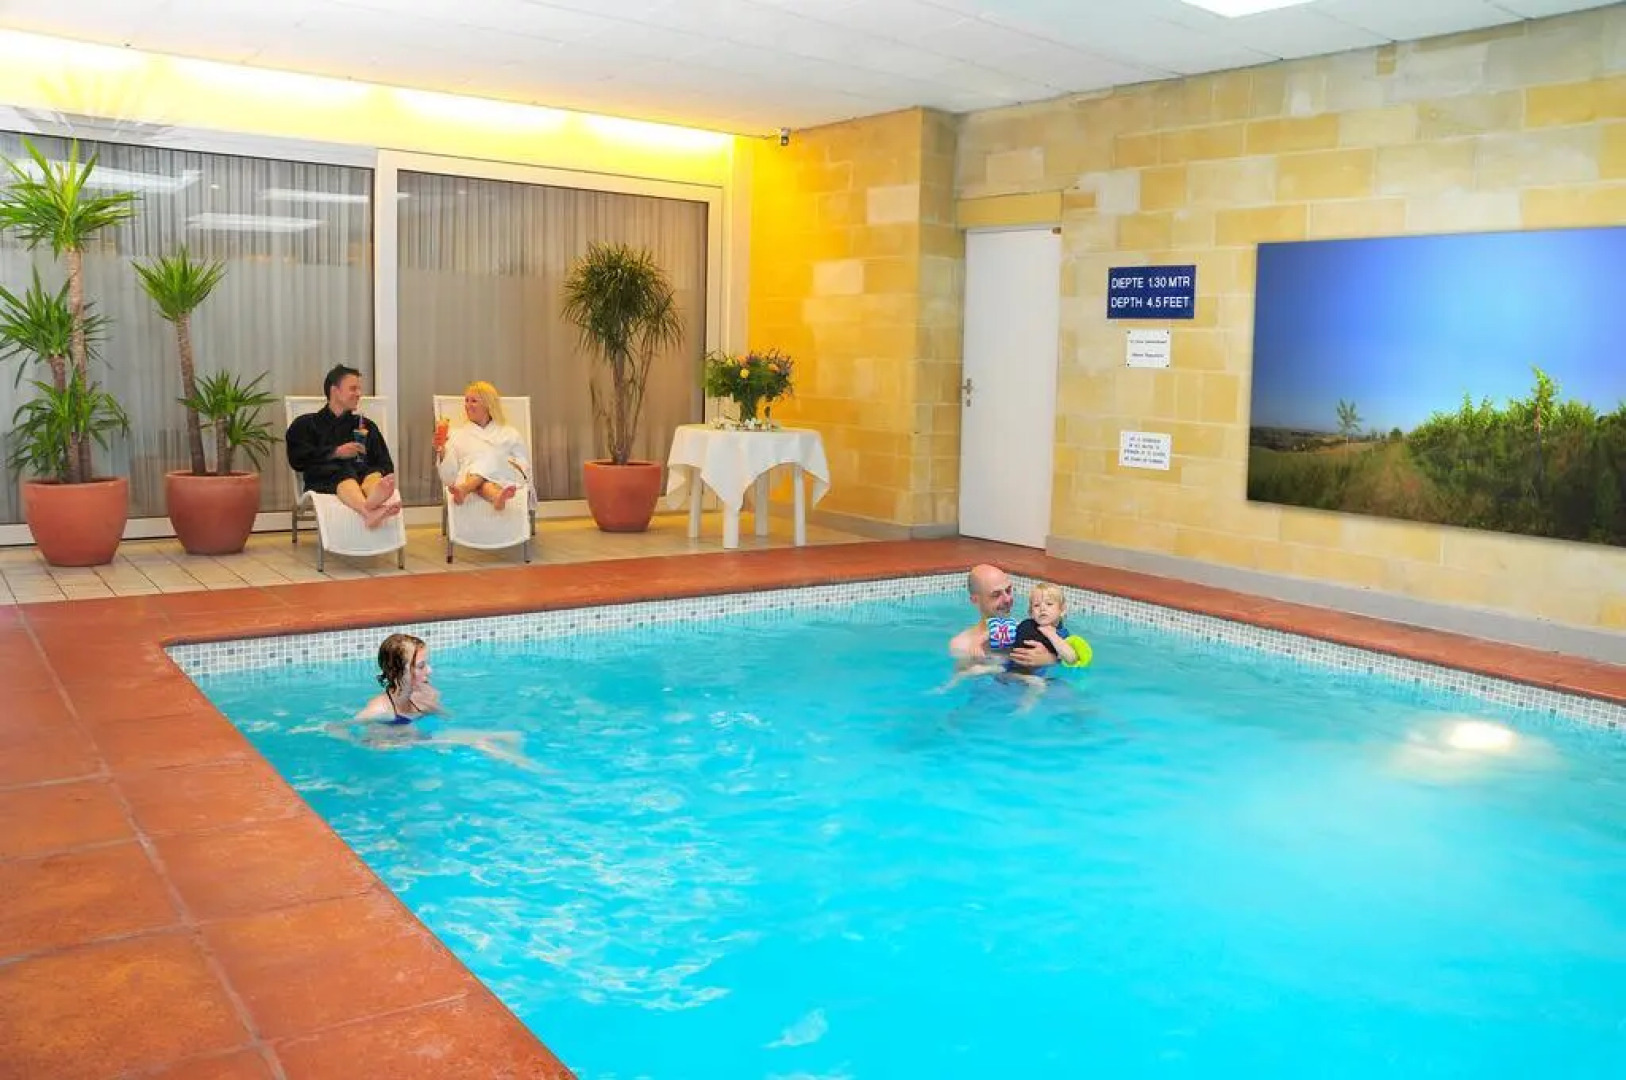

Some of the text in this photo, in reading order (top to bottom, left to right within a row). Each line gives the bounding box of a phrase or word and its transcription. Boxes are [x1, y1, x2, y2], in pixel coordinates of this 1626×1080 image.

[1111, 277, 1144, 289] DIEPTE
[1168, 276, 1190, 288] MTR
[1111, 296, 1190, 308] DEPTH 4.5 FEET
